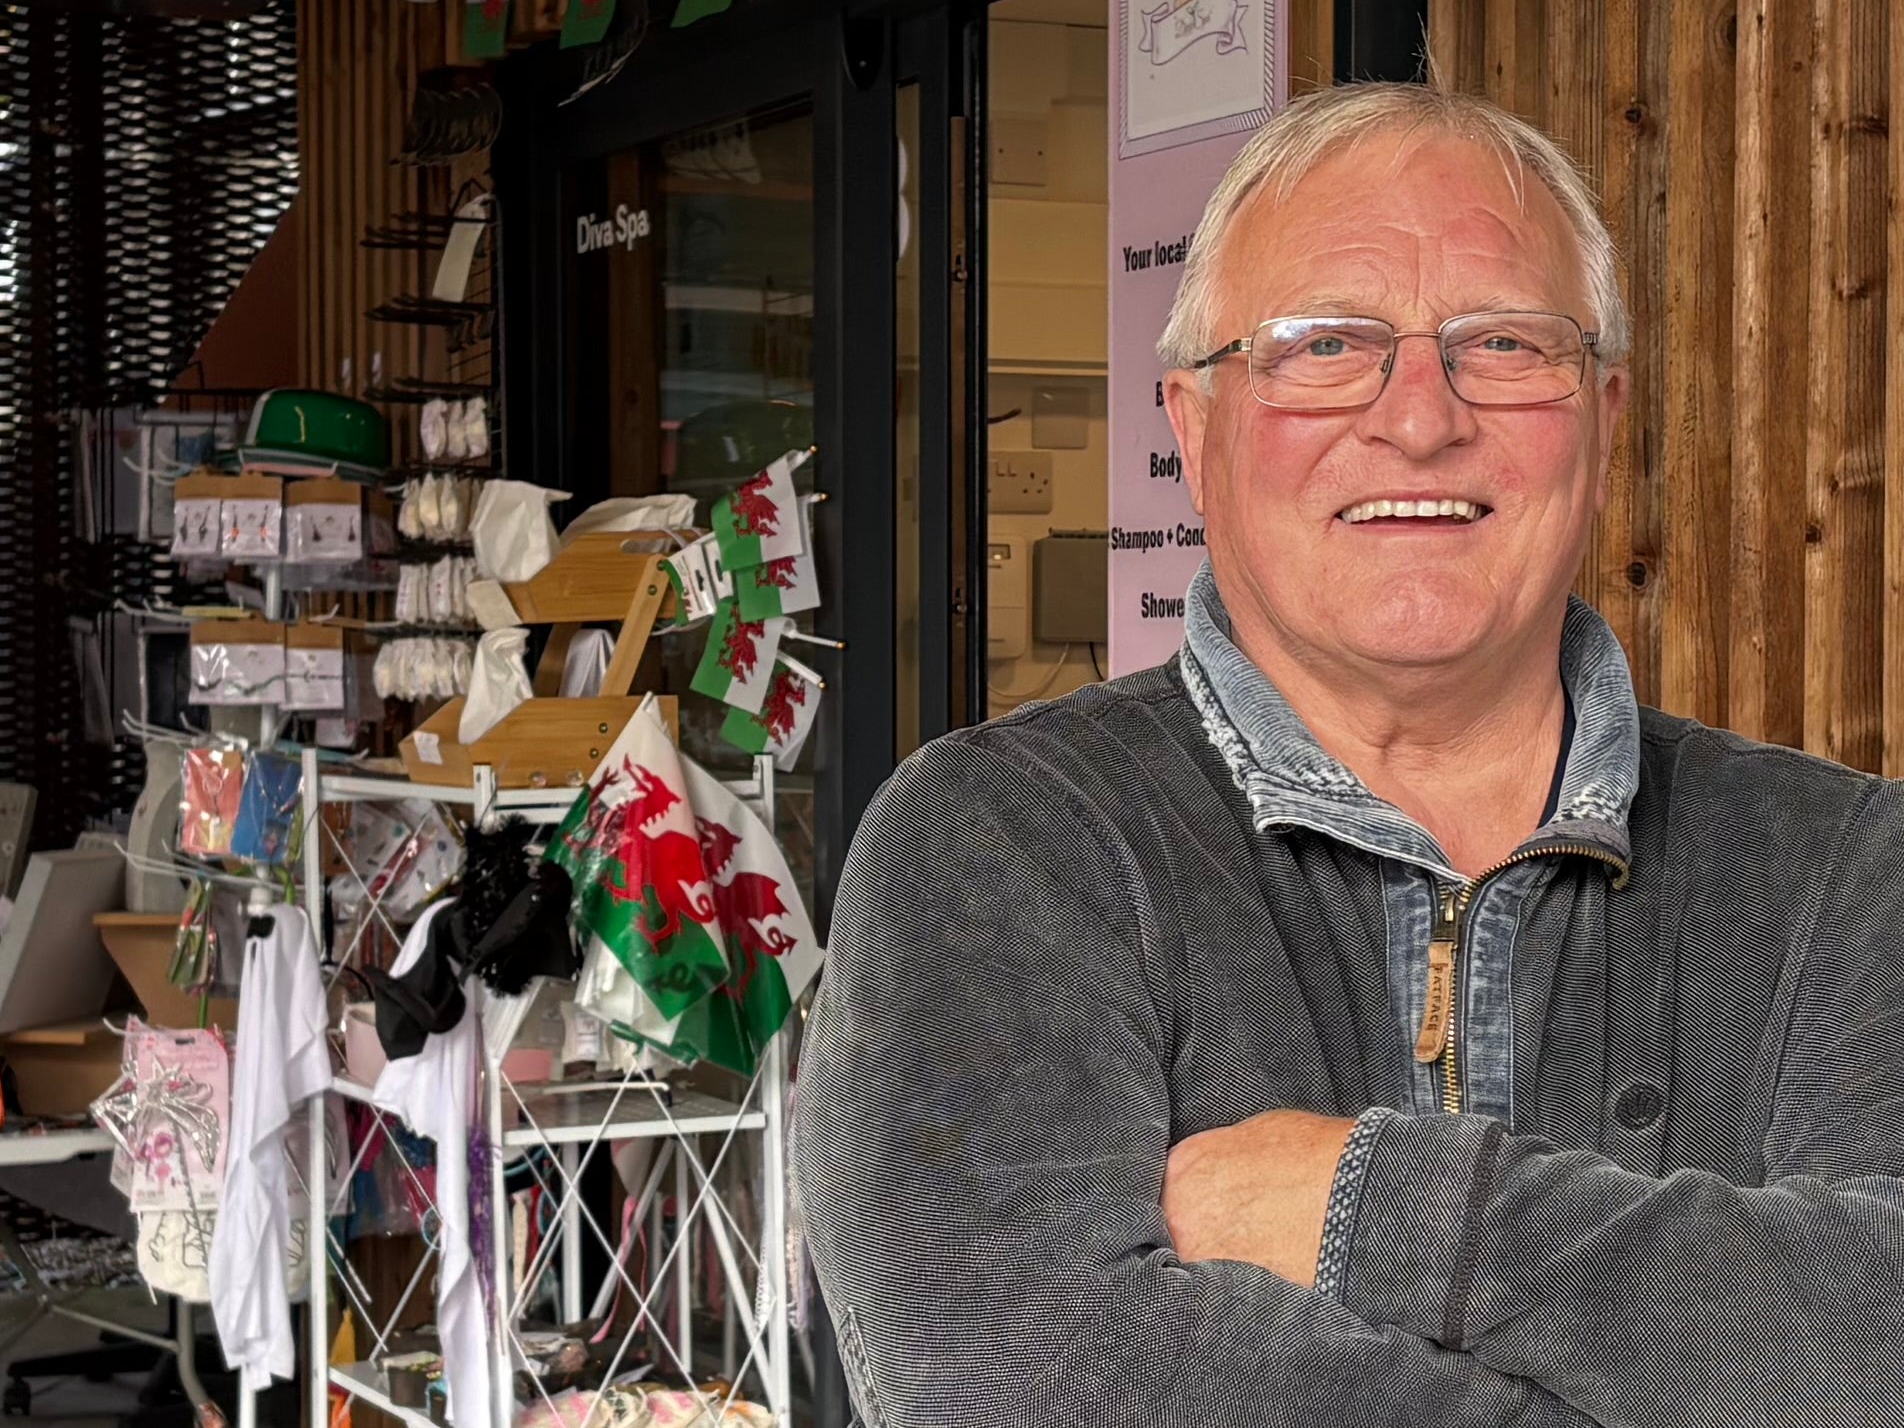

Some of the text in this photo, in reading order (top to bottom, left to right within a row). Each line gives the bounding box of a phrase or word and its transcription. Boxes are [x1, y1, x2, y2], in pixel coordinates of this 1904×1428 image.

[576, 203, 651, 254] Diva Spa
[1123, 244, 1152, 273] Your
[1155, 234, 1187, 268] local
[1150, 450, 1182, 482] Body
[1111, 526, 1165, 554] Shampoo
